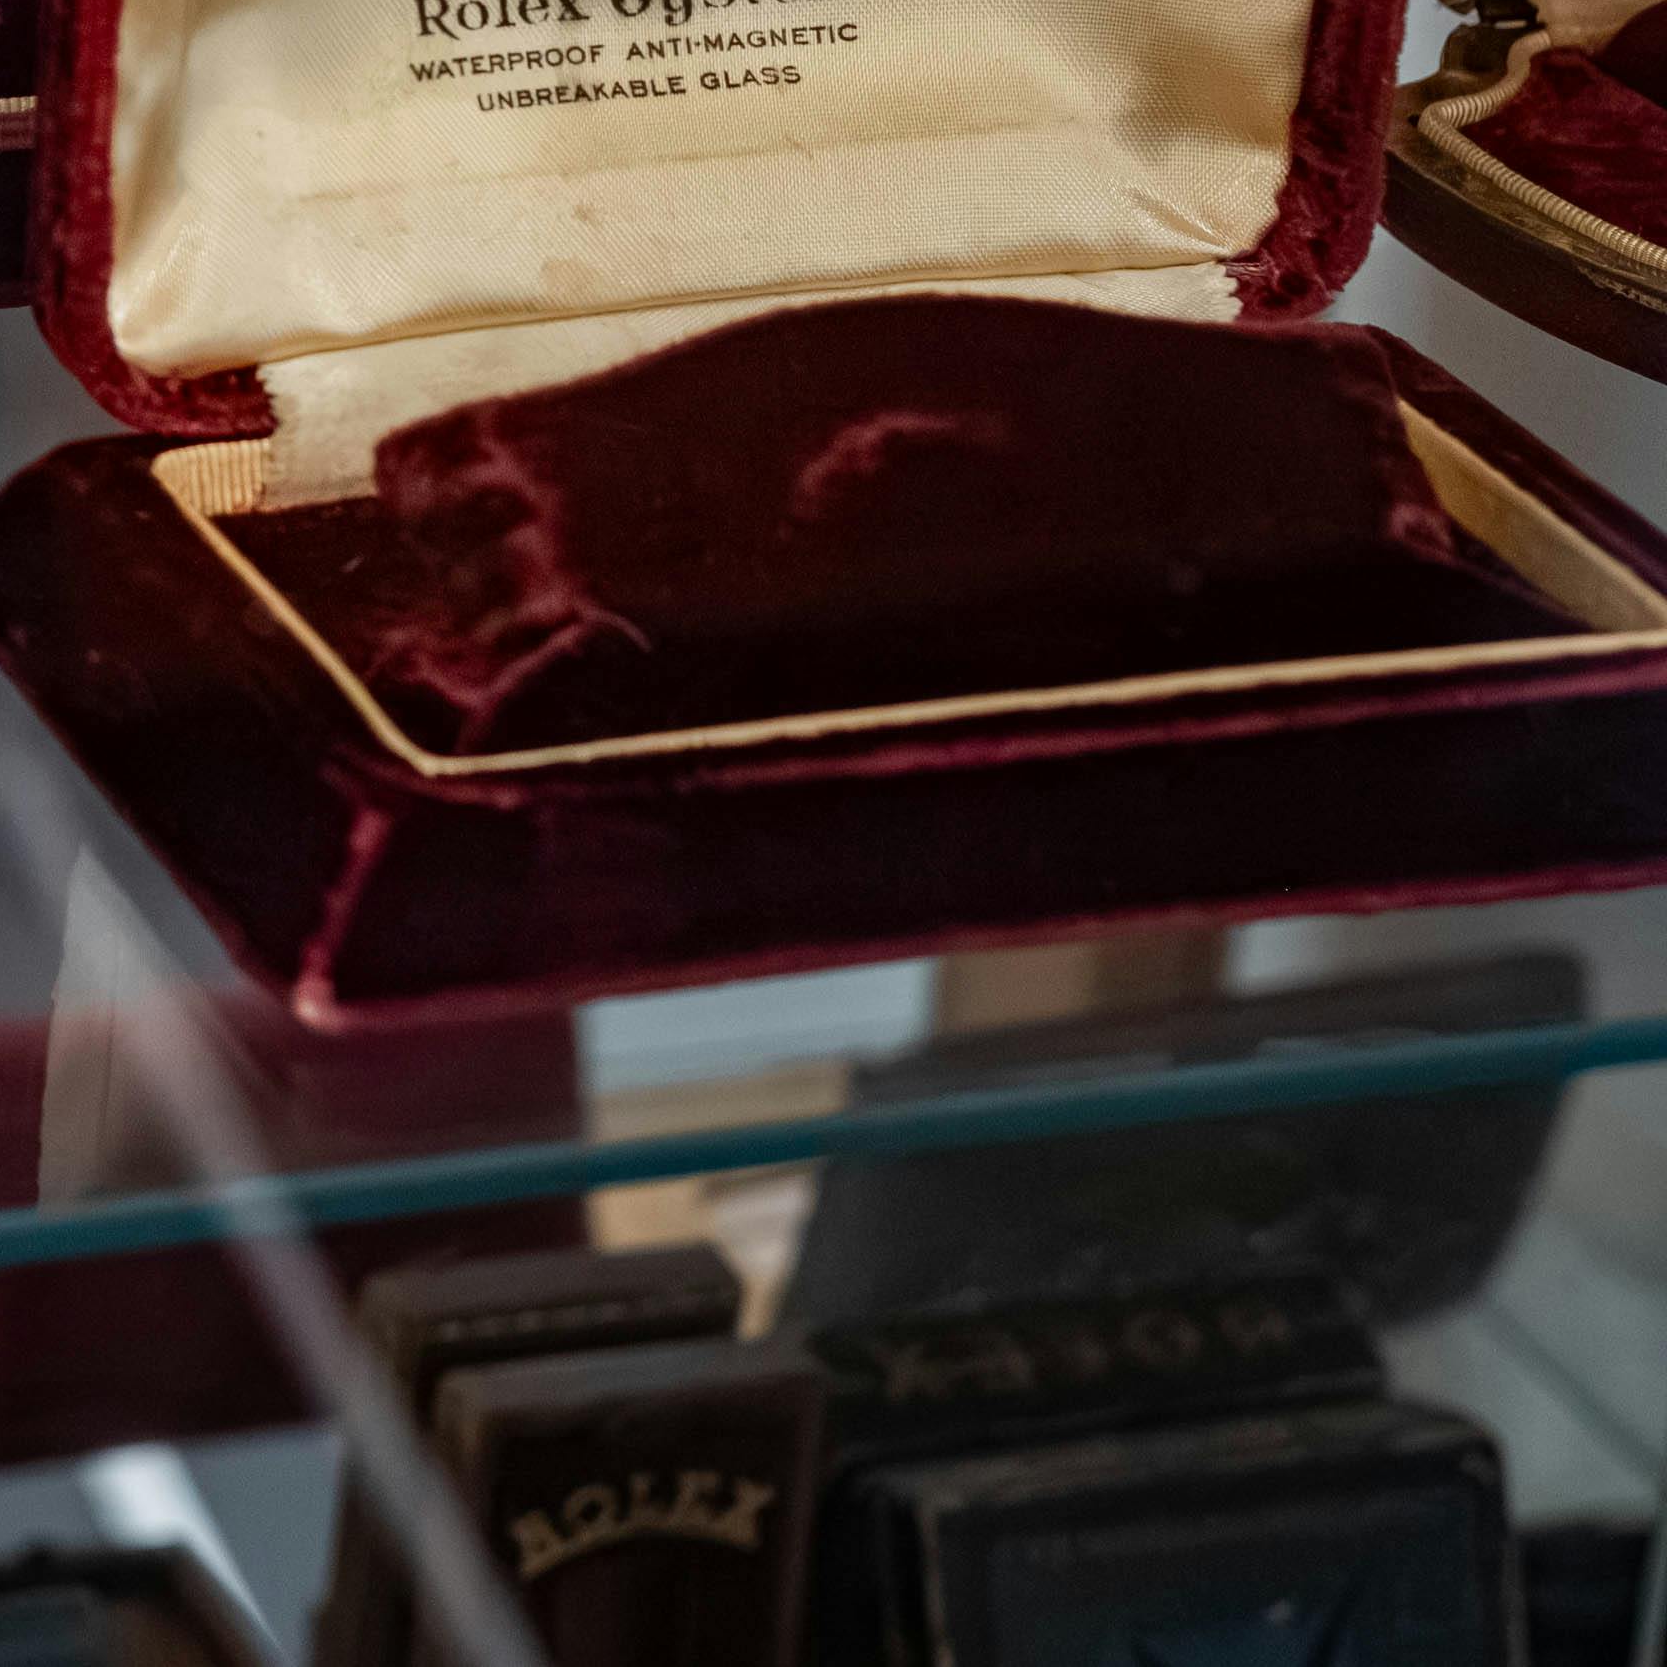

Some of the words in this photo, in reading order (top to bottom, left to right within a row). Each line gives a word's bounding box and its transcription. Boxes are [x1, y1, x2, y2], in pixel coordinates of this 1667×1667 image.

[409, 44, 605, 83] WATERPROOF
[626, 23, 860, 61] ANTI-MAGNETIC
[476, 76, 686, 113] UNBREAKABLE
[699, 65, 802, 91] GLASS
